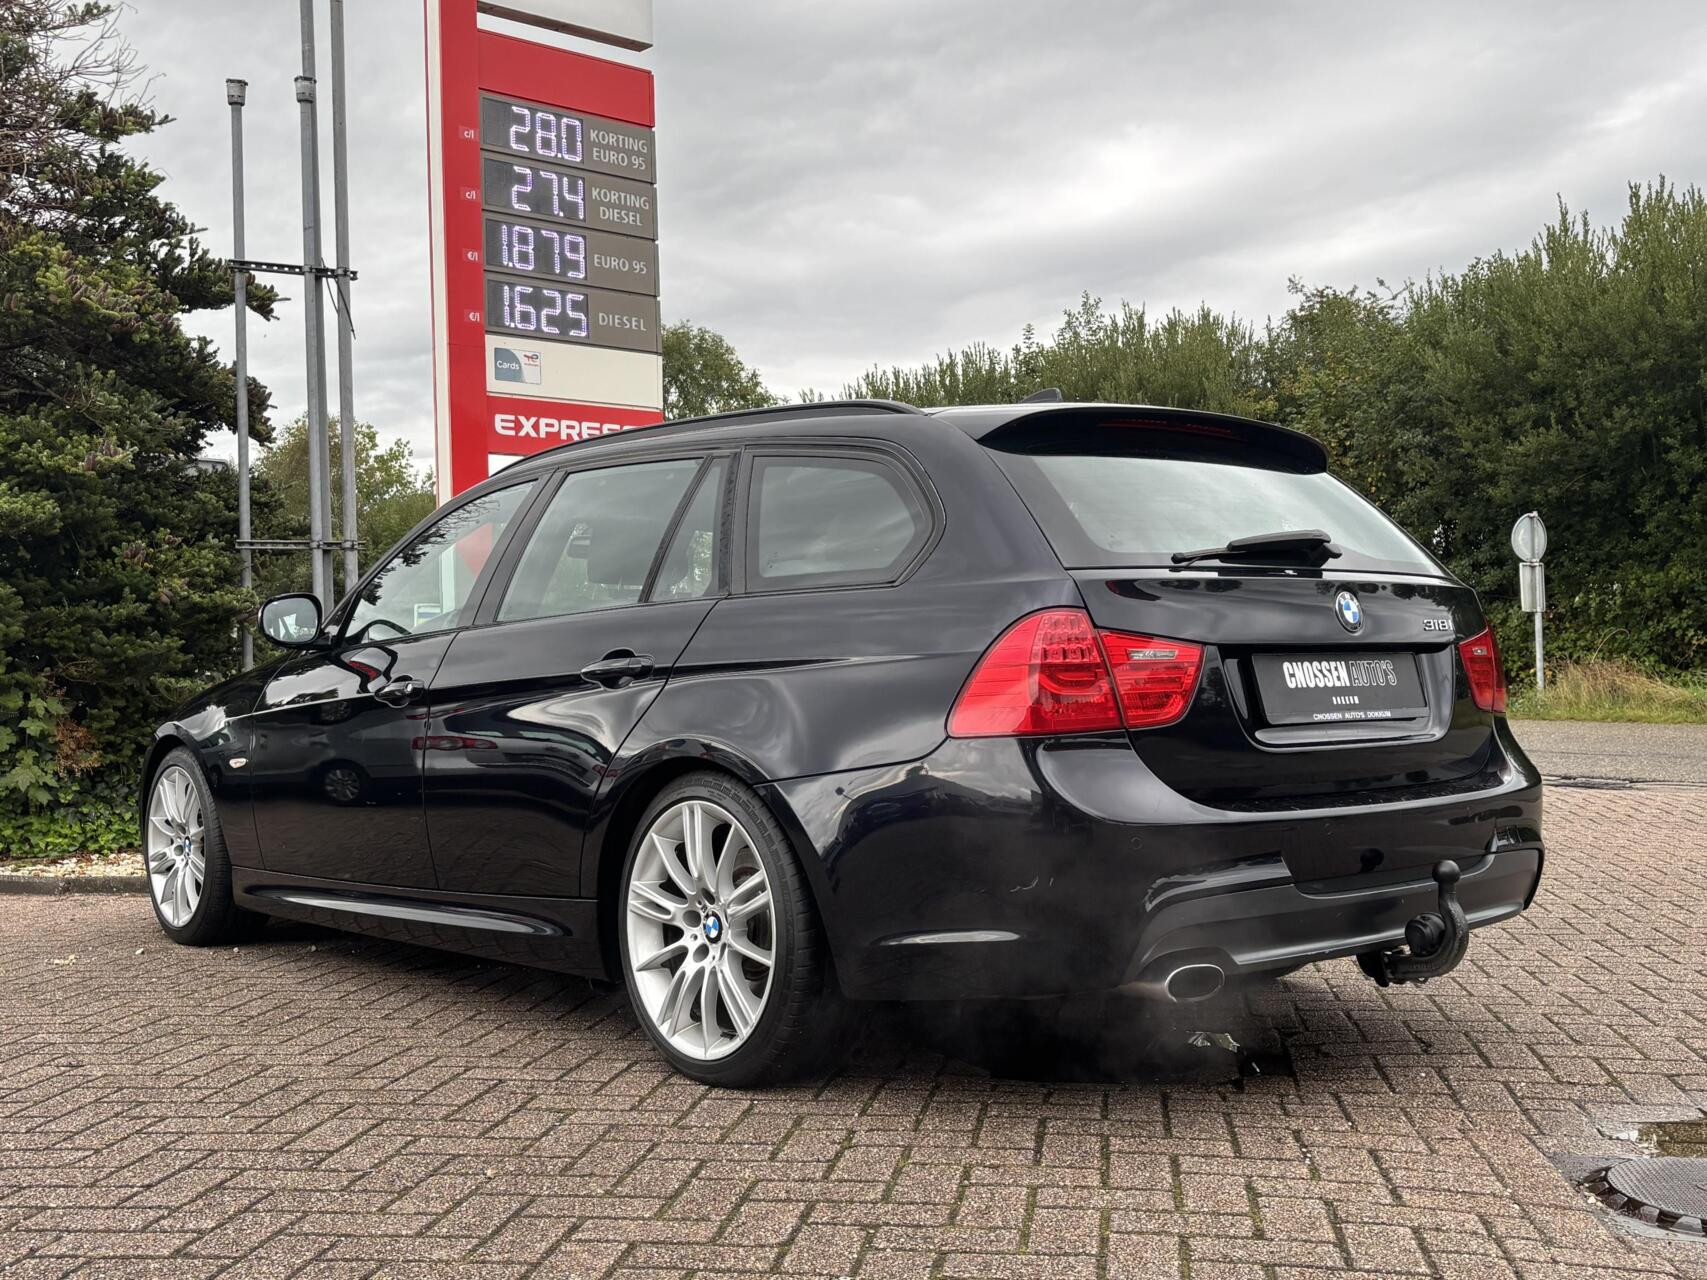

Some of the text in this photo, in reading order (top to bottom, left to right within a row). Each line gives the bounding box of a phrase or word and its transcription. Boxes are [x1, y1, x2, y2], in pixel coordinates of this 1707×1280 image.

[510, 106, 582, 162] 28.0
[590, 129, 648, 154] KORTING
[593, 147, 646, 170] EURO 95
[511, 165, 584, 220] 27.4
[592, 187, 649, 210] KORTING
[600, 206, 643, 227] DIESEL
[501, 224, 585, 278] 1.879
[594, 254, 647, 274] EURO 95
[503, 285, 587, 337] 1.625
[599, 312, 647, 332] DIESEL
[496, 360, 520, 370] Cards
[1282, 660, 1397, 689] CNOSSEN AUTO'S
